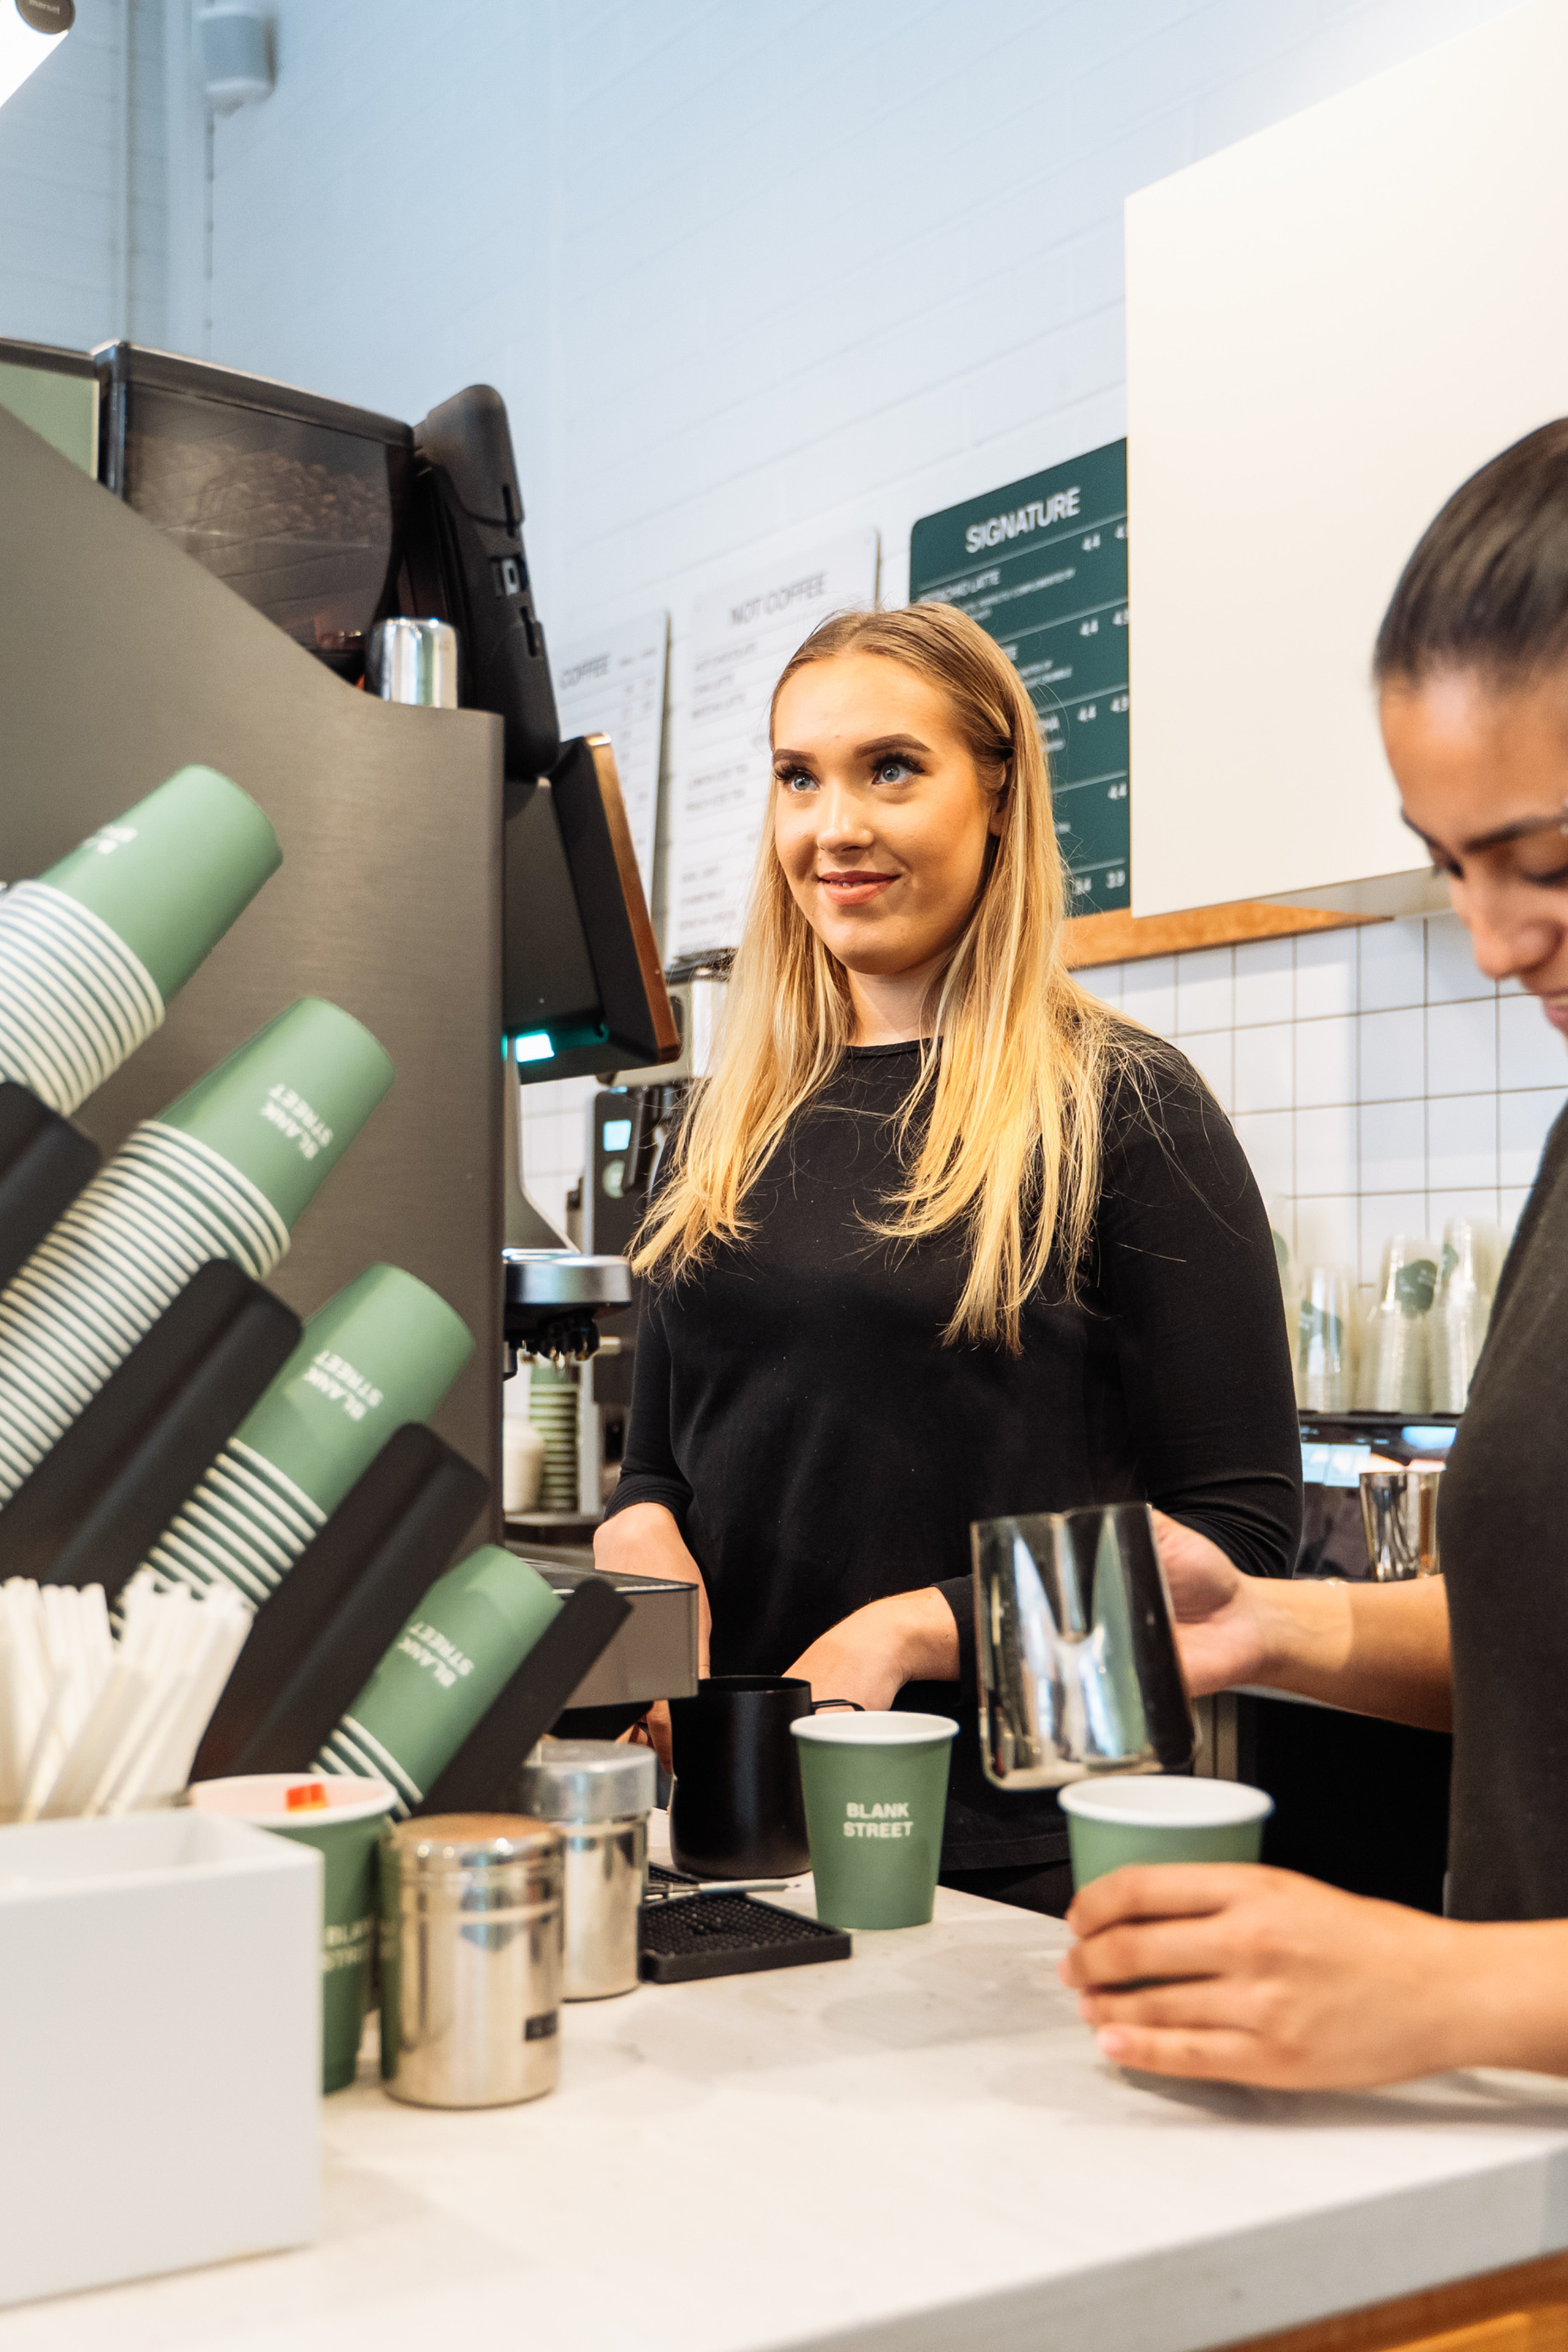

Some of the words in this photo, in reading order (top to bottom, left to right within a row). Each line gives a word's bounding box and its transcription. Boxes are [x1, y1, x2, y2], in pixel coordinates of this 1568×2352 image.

[965, 486, 1081, 554] SIGNATURE
[730, 596, 761, 626] NOT
[765, 570, 827, 615] COFFEE
[560, 652, 609, 690] COFFEE
[303, 1366, 367, 1421] BLANK
[314, 1349, 384, 1408] STREET
[398, 1637, 456, 1687] BLANK
[408, 1621, 474, 1676] STREET
[843, 1821, 914, 1838] STREET
[846, 1802, 910, 1819] BLANK
